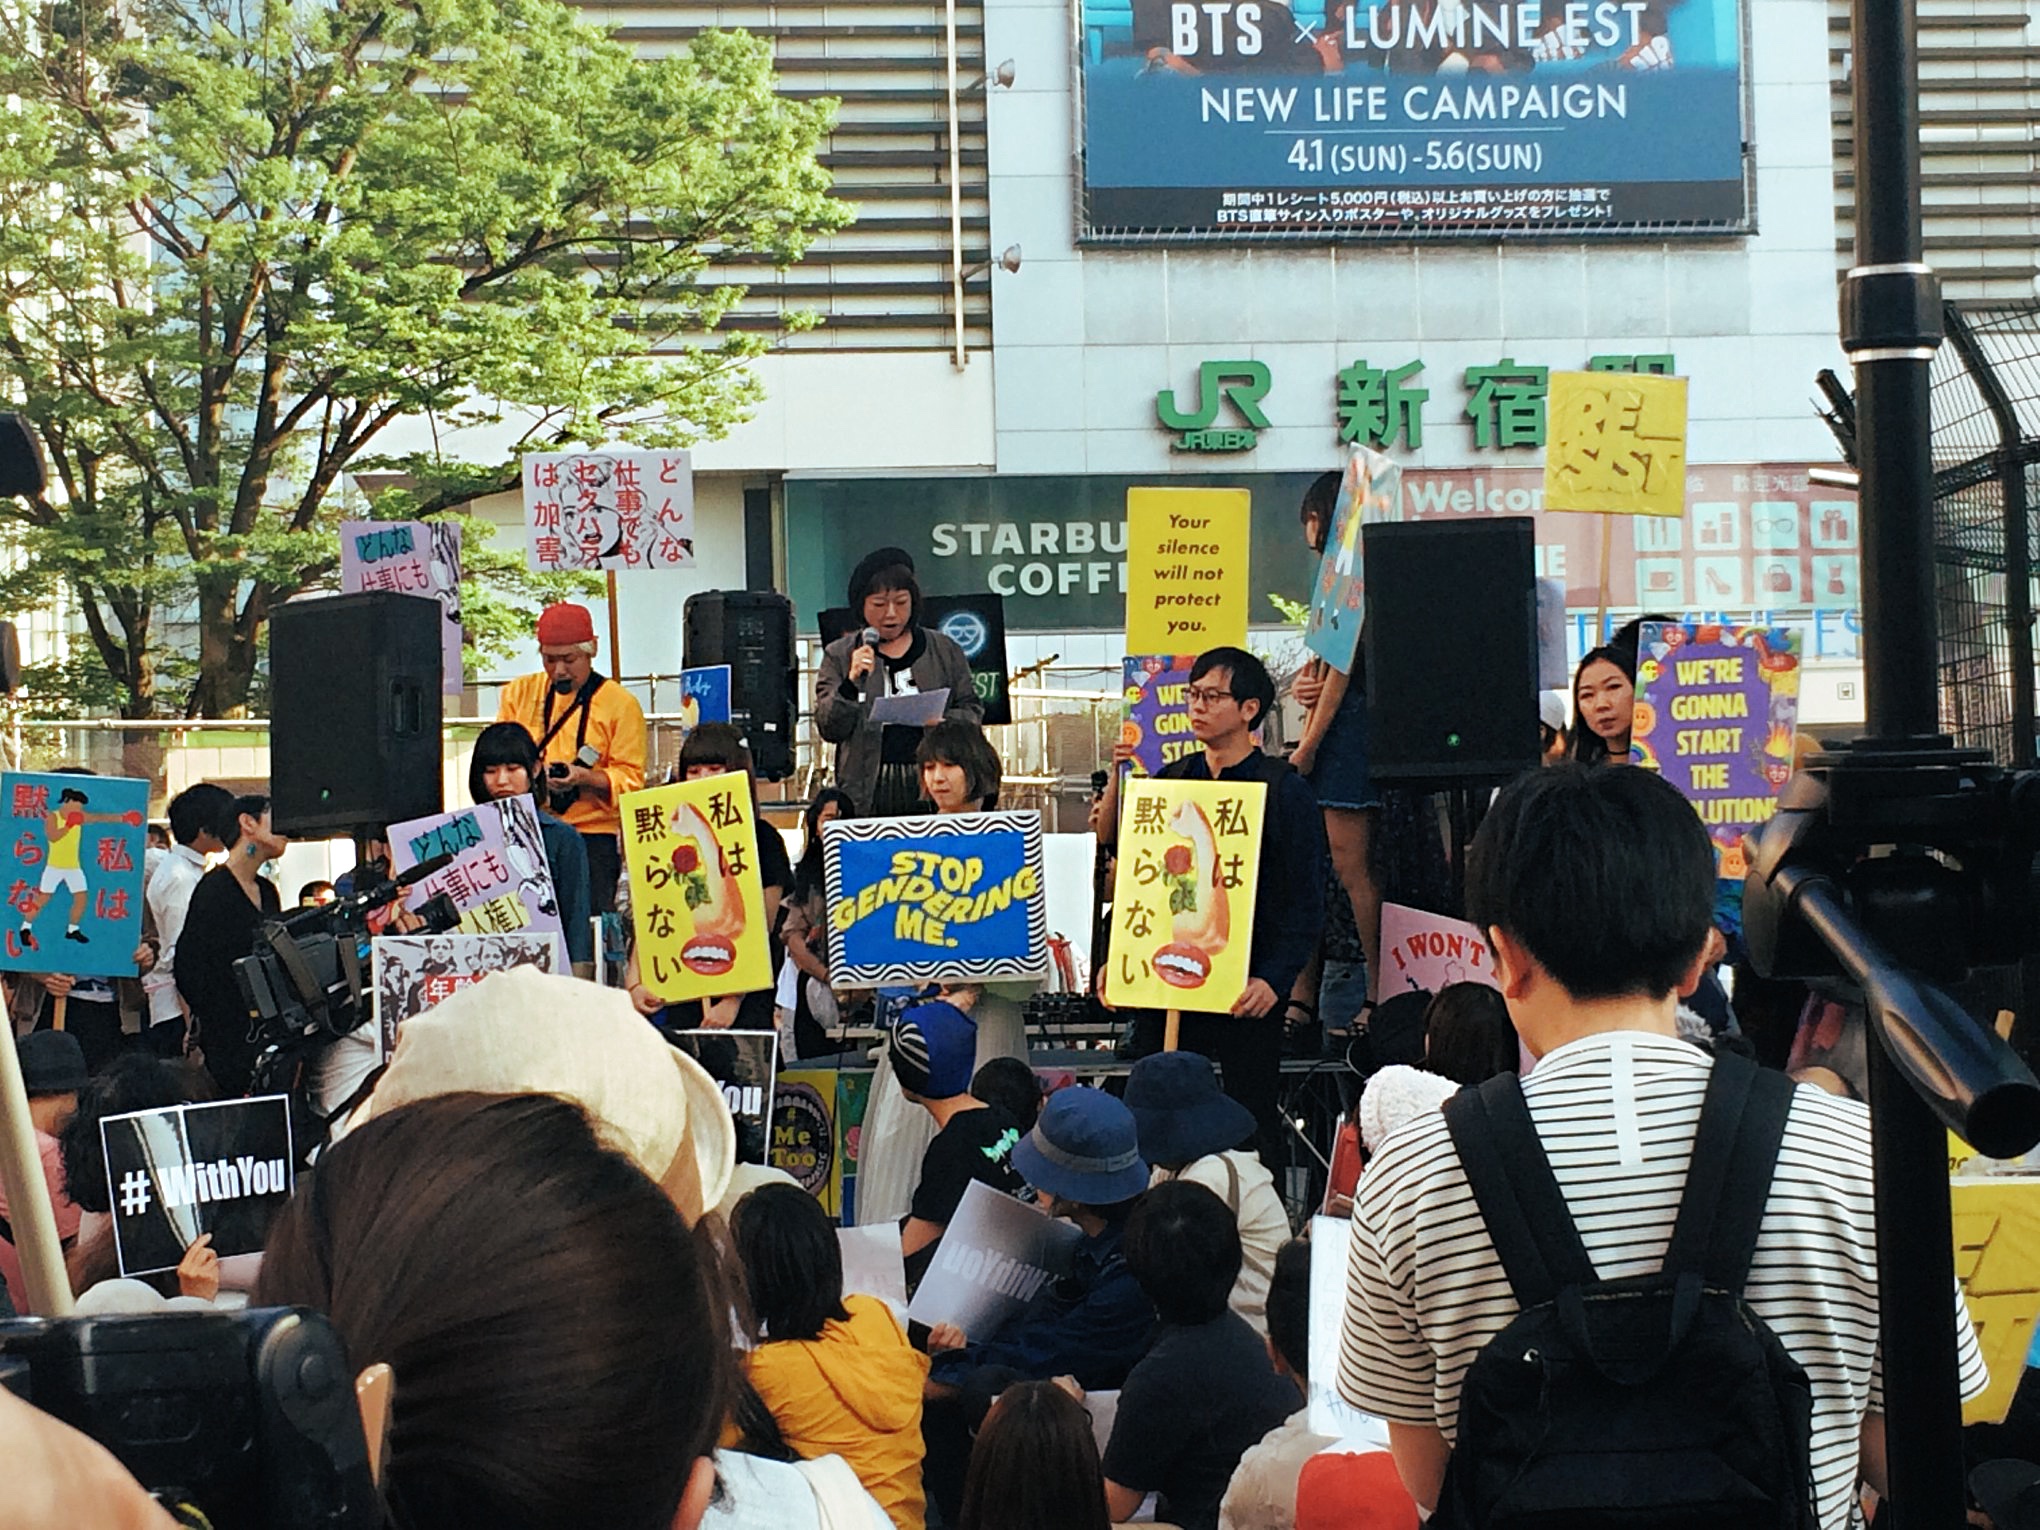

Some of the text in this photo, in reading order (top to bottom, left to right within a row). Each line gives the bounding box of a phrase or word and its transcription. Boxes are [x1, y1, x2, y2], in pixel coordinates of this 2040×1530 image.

[1171, 3, 1262, 56] BTS
[1346, 3, 1542, 49] LUMINE
[1565, 2, 1647, 47] EST
[1201, 84, 1627, 123] NEW LIFE CAMPAIGN
[1157, 361, 1273, 430] JR
[1338, 354, 1675, 450] 新宿
[534, 463, 562, 563] は加害
[614, 459, 642, 565] 仕事でも
[658, 458, 684, 562] どんな
[1169, 514, 1211, 529] Your
[359, 524, 411, 564] どんな
[931, 521, 1127, 556] STARBU
[1157, 539, 1220, 555] silence
[988, 562, 1127, 597] COFF
[1154, 565, 1224, 580] will not
[1154, 593, 1221, 609] protect
[1167, 620, 1207, 635] you.
[1675, 657, 1744, 686] WE'RE
[1671, 692, 1748, 721] GONNA
[1676, 728, 1743, 756] START
[1690, 763, 1730, 790] THE
[707, 791, 749, 879] 私は
[1213, 798, 1249, 890] 私は
[6, 784, 50, 958] 黙らない
[97, 838, 134, 920] 私は
[889, 851, 983, 895] STOP
[1121, 797, 1167, 985] 黙らない
[634, 804, 682, 984] 黙らない
[831, 865, 1038, 932] GENDERING
[894, 904, 958, 948] ME.
[1391, 931, 1486, 971] I WON'T
[773, 1126, 813, 1146] Me
[769, 1148, 817, 1169] Too
